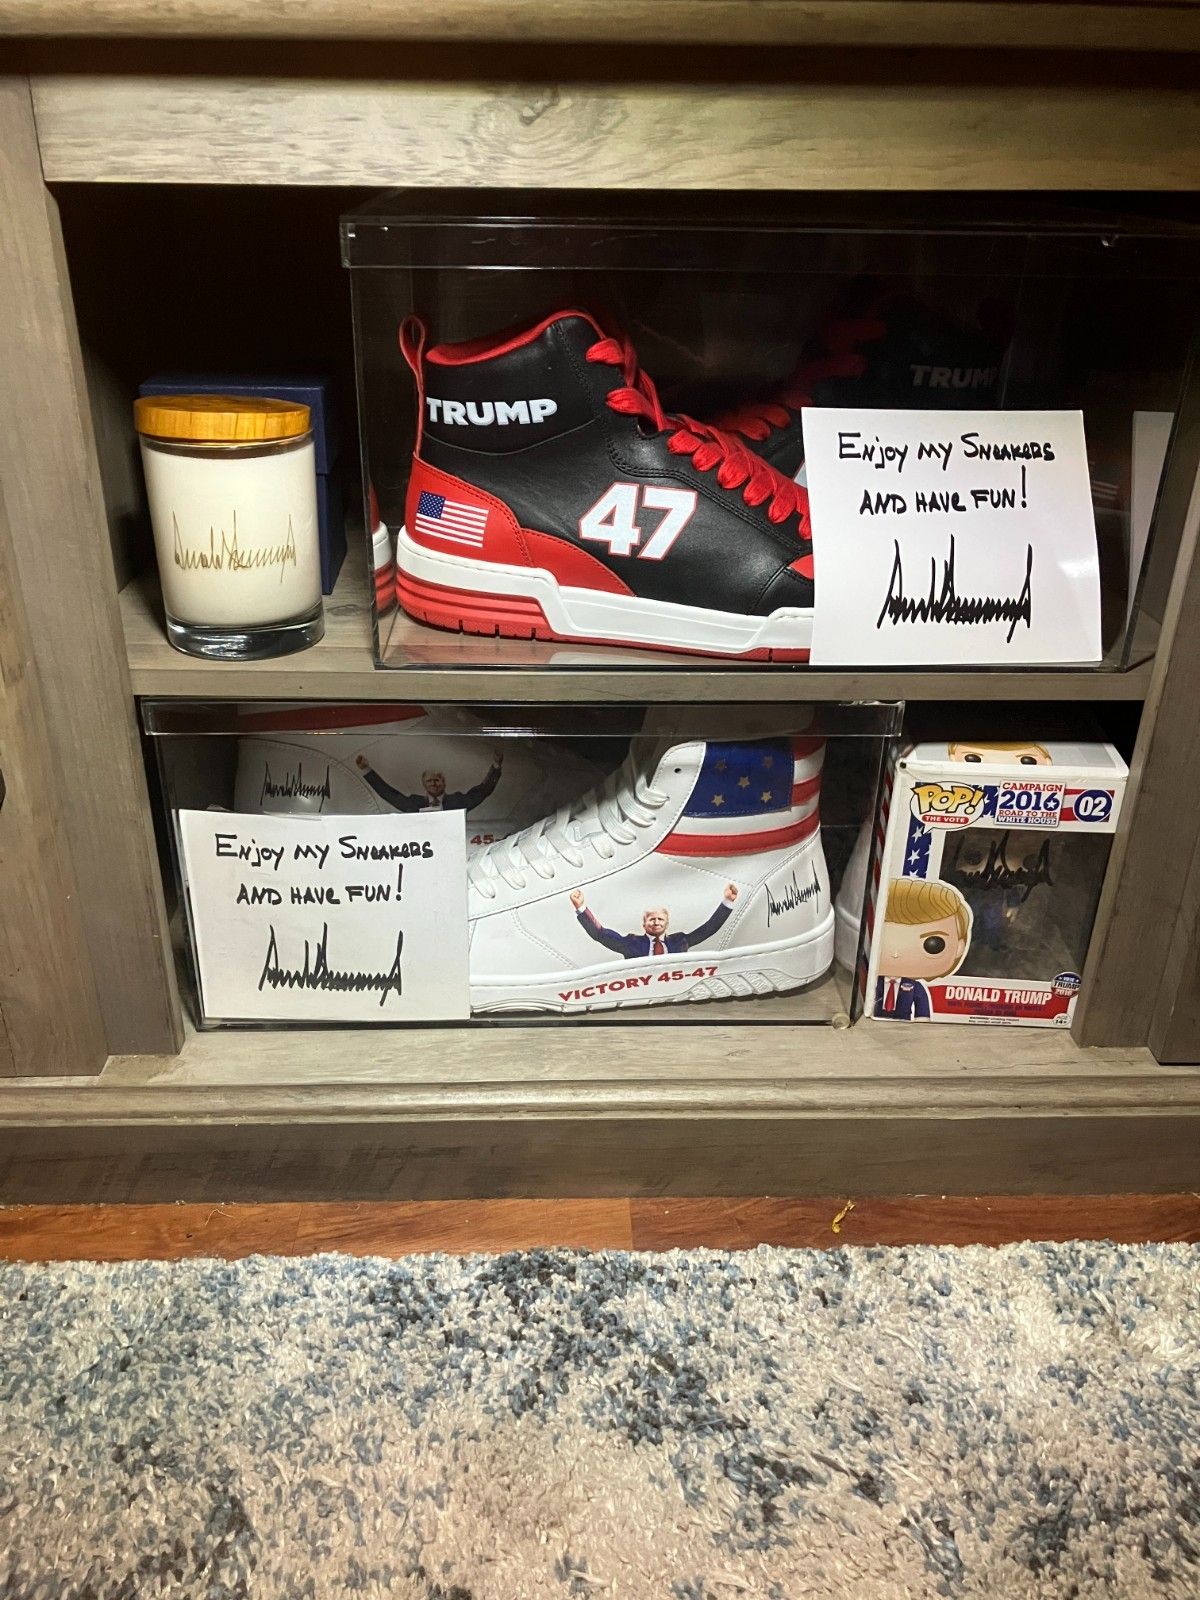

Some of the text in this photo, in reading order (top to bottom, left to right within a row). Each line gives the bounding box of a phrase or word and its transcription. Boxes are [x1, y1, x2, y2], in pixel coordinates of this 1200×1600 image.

[426, 396, 558, 426] TRUMP
[859, 489, 907, 515] AND
[970, 465, 1027, 509] FUN!
[578, 481, 698, 561] 47
[1002, 783, 1063, 793] CAMPAIGN
[1000, 790, 1060, 811] 2016
[1078, 796, 1108, 817] 02
[925, 815, 966, 824] THE VOTE
[997, 816, 1057, 825] WHITE HOUSE
[999, 809, 1024, 817] ROAD
[236, 883, 282, 905] AND
[345, 863, 404, 902] FUN!
[558, 966, 719, 1001] VICTORY 45-47
[1054, 982, 1080, 990] TRUMP
[945, 986, 1052, 1005] DONALD TRUMP
